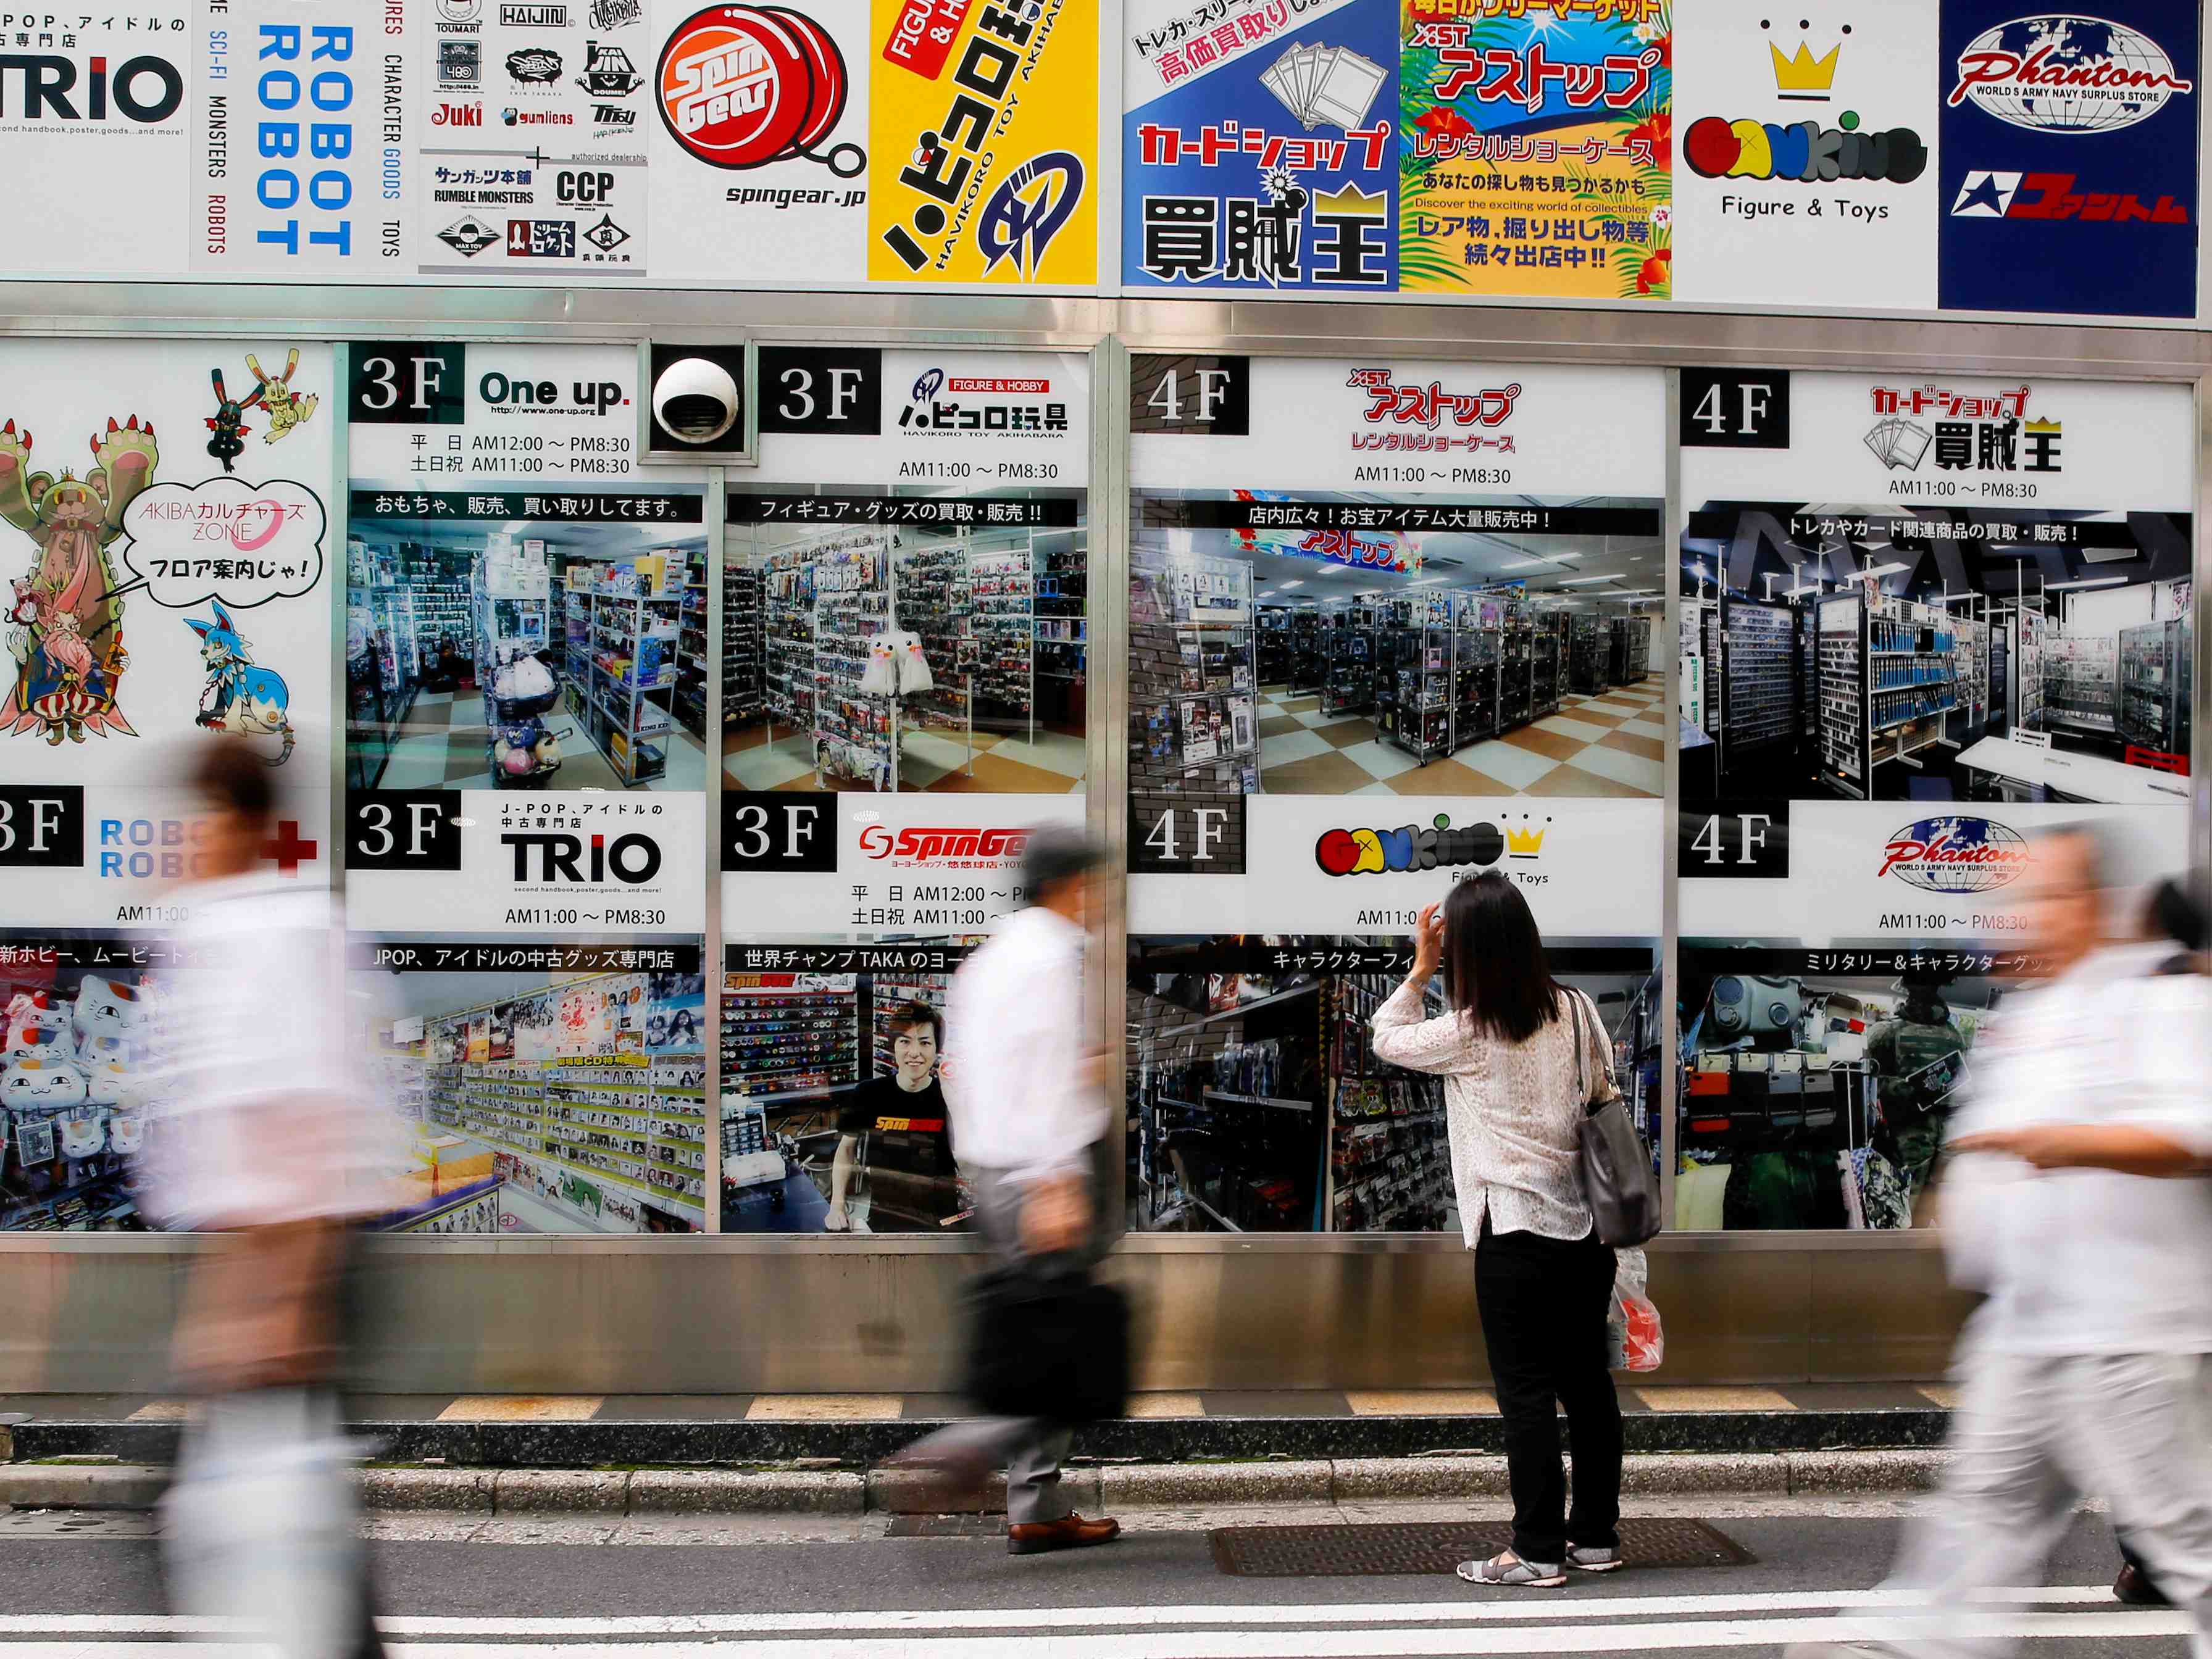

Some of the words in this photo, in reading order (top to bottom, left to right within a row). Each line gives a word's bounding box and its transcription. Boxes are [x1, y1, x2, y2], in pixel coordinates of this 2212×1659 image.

[930, 27, 954, 44] &
[210, 31, 227, 78] SCI-FI
[1434, 43, 1662, 112] アストップ
[1948, 45, 2189, 106] Phantom
[384, 56, 402, 141] CHARACTER
[1977, 86, 2010, 95] WORLD
[2023, 88, 2049, 97] ARMY
[2053, 89, 2078, 98] NAVY
[2081, 91, 2125, 100] SURPLUS
[2128, 92, 2160, 102] STORE
[209, 96, 226, 177] MONSTERS
[257, 25, 301, 254] ROBOT
[309, 27, 353, 256] ROBOT
[1138, 120, 1390, 170] カードショップ
[1414, 133, 1655, 165] レンタルショーケース
[611, 154, 647, 162] dealership
[383, 149, 400, 199] GOODS
[557, 172, 614, 201] CCP
[936, 152, 994, 270] HAVIKORO
[995, 94, 1018, 137] TOY
[1423, 173, 1645, 194] あなたの探し物も見つかるかも
[435, 190, 476, 202] RUMBLE
[478, 191, 534, 204] MONSTERS
[727, 188, 866, 209] spingear.jp
[1415, 198, 1466, 209] Discover
[1469, 200, 1486, 209] the
[1489, 201, 1534, 212] exciting
[1537, 203, 1567, 212] world
[1570, 204, 1583, 212] of
[1586, 204, 1648, 214] collectibles
[1723, 196, 1794, 219] Figure
[1808, 199, 1821, 216] &
[1835, 200, 1888, 223] Toys
[208, 196, 225, 253] ROBOTS
[383, 220, 399, 256] TOYS
[362, 358, 446, 409] 3F
[480, 372, 557, 404] One
[780, 368, 862, 419] 3F
[953, 380, 992, 390] FIGURE
[996, 381, 1004, 390] &
[1008, 381, 1043, 391] HOBBY
[1147, 370, 1231, 421] 4F
[1364, 383, 1521, 430] アストップ
[1693, 385, 1771, 433] 4F
[1872, 385, 2031, 420] カードショップ
[472, 436, 542, 451] AM12:00
[571, 438, 629, 452] PM8:30
[1352, 432, 1515, 453] レンタルショーケース
[411, 455, 463, 472] 土日祝
[472, 457, 542, 472] AM11:00
[571, 459, 629, 473] PM8:30
[899, 462, 970, 476] AM11:00
[999, 464, 1057, 478] PM8:30
[1355, 467, 1424, 481] AM11:00
[1453, 469, 1510, 483] PM8:30
[1890, 481, 1955, 496] AM11:00
[1982, 483, 2037, 497] PM8:30
[193, 523, 252, 541] ZONE
[359, 804, 442, 855] 3F
[502, 817, 581, 828] 中古専門店
[735, 806, 818, 857] 3F
[1145, 809, 1228, 860] 4F
[1691, 815, 1771, 864] 4F
[501, 833, 661, 884] TRIO
[1877, 835, 2039, 877] Phantom
[914, 887, 984, 901] AM12:00
[1517, 872, 1548, 886] Toys
[506, 909, 577, 923] AM11:00
[606, 910, 664, 924] PM8:30
[852, 908, 904, 925] 土日祝
[914, 910, 984, 924] AM11:00
[1358, 910, 1418, 925] AM11:0
[1879, 914, 1946, 929] AM11:00
[374, 948, 674, 968] JPOP、アイドルの中古グッズ専門店
[745, 949, 856, 968] 世界チャンプ
[860, 952, 904, 967] TAKA
